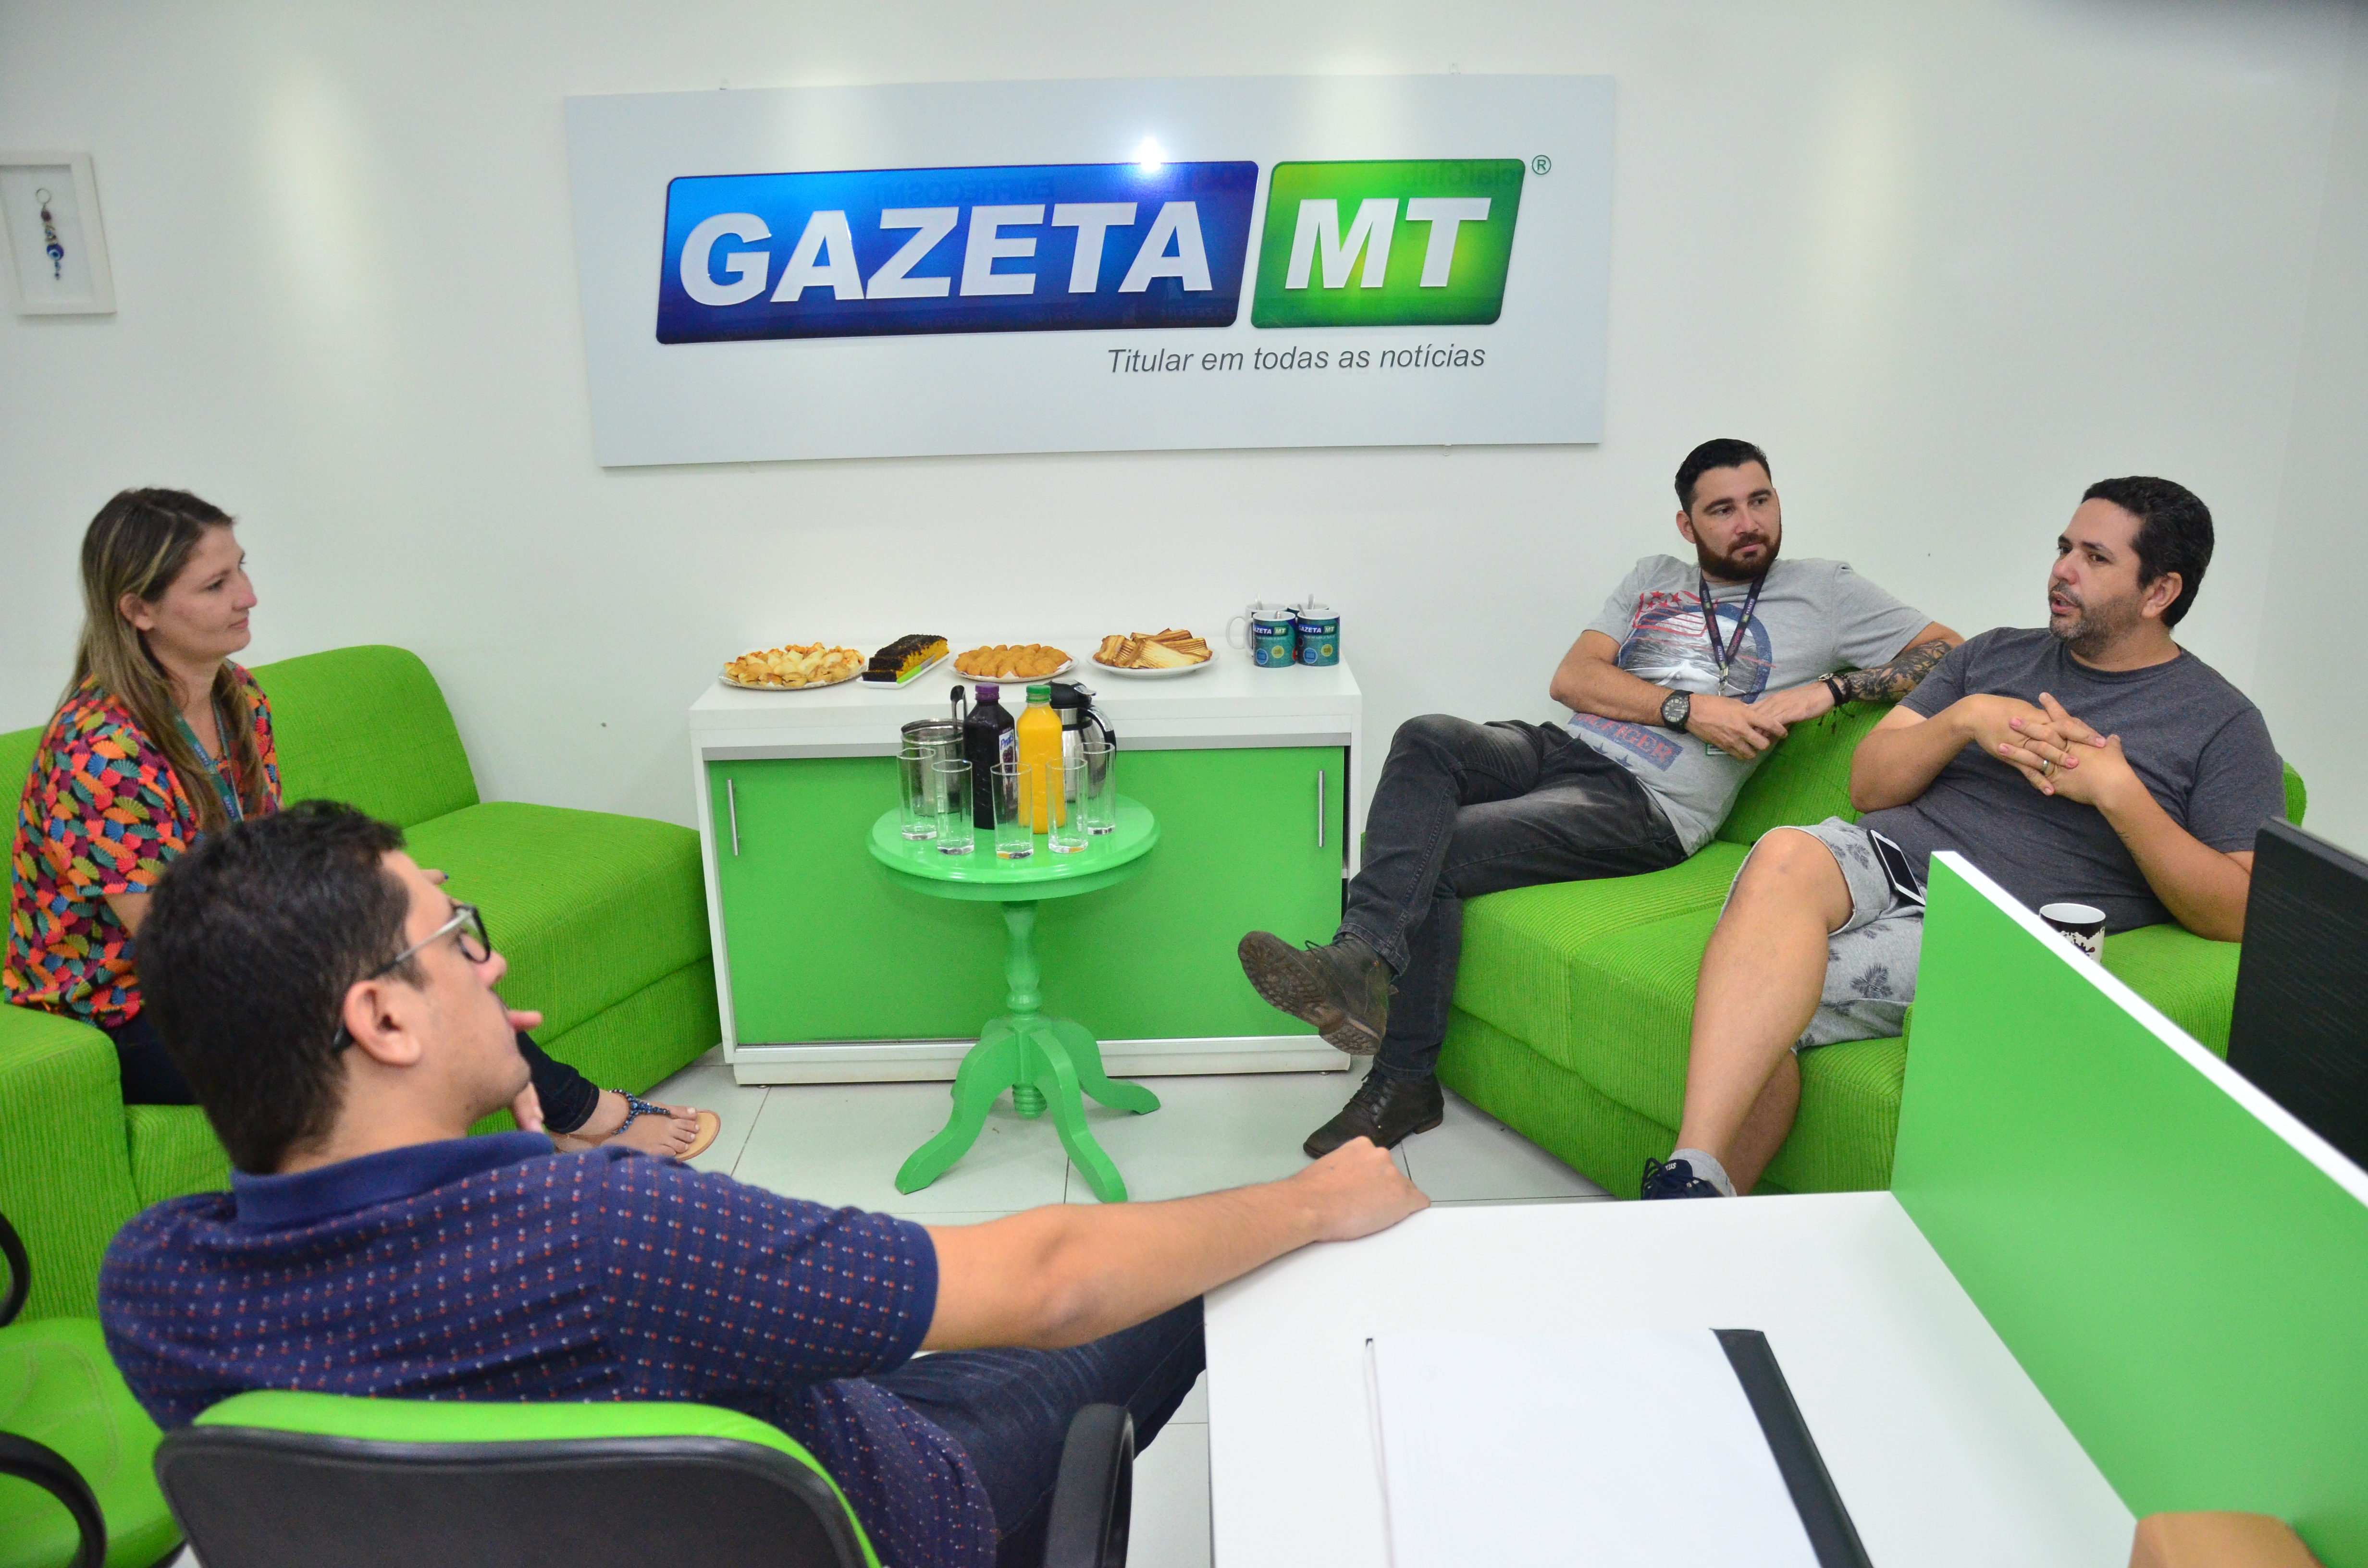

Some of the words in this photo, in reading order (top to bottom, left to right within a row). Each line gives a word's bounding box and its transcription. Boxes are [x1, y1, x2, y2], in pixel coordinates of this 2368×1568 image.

[680, 201, 1212, 306] GAZETA
[1285, 197, 1492, 289] MT
[1107, 348, 1195, 373] Titular
[1202, 352, 1244, 370] em
[1254, 345, 1329, 370] todas
[1338, 350, 1370, 368] as
[1380, 343, 1486, 368] notícias
[1298, 625, 1322, 634] GAZETA
